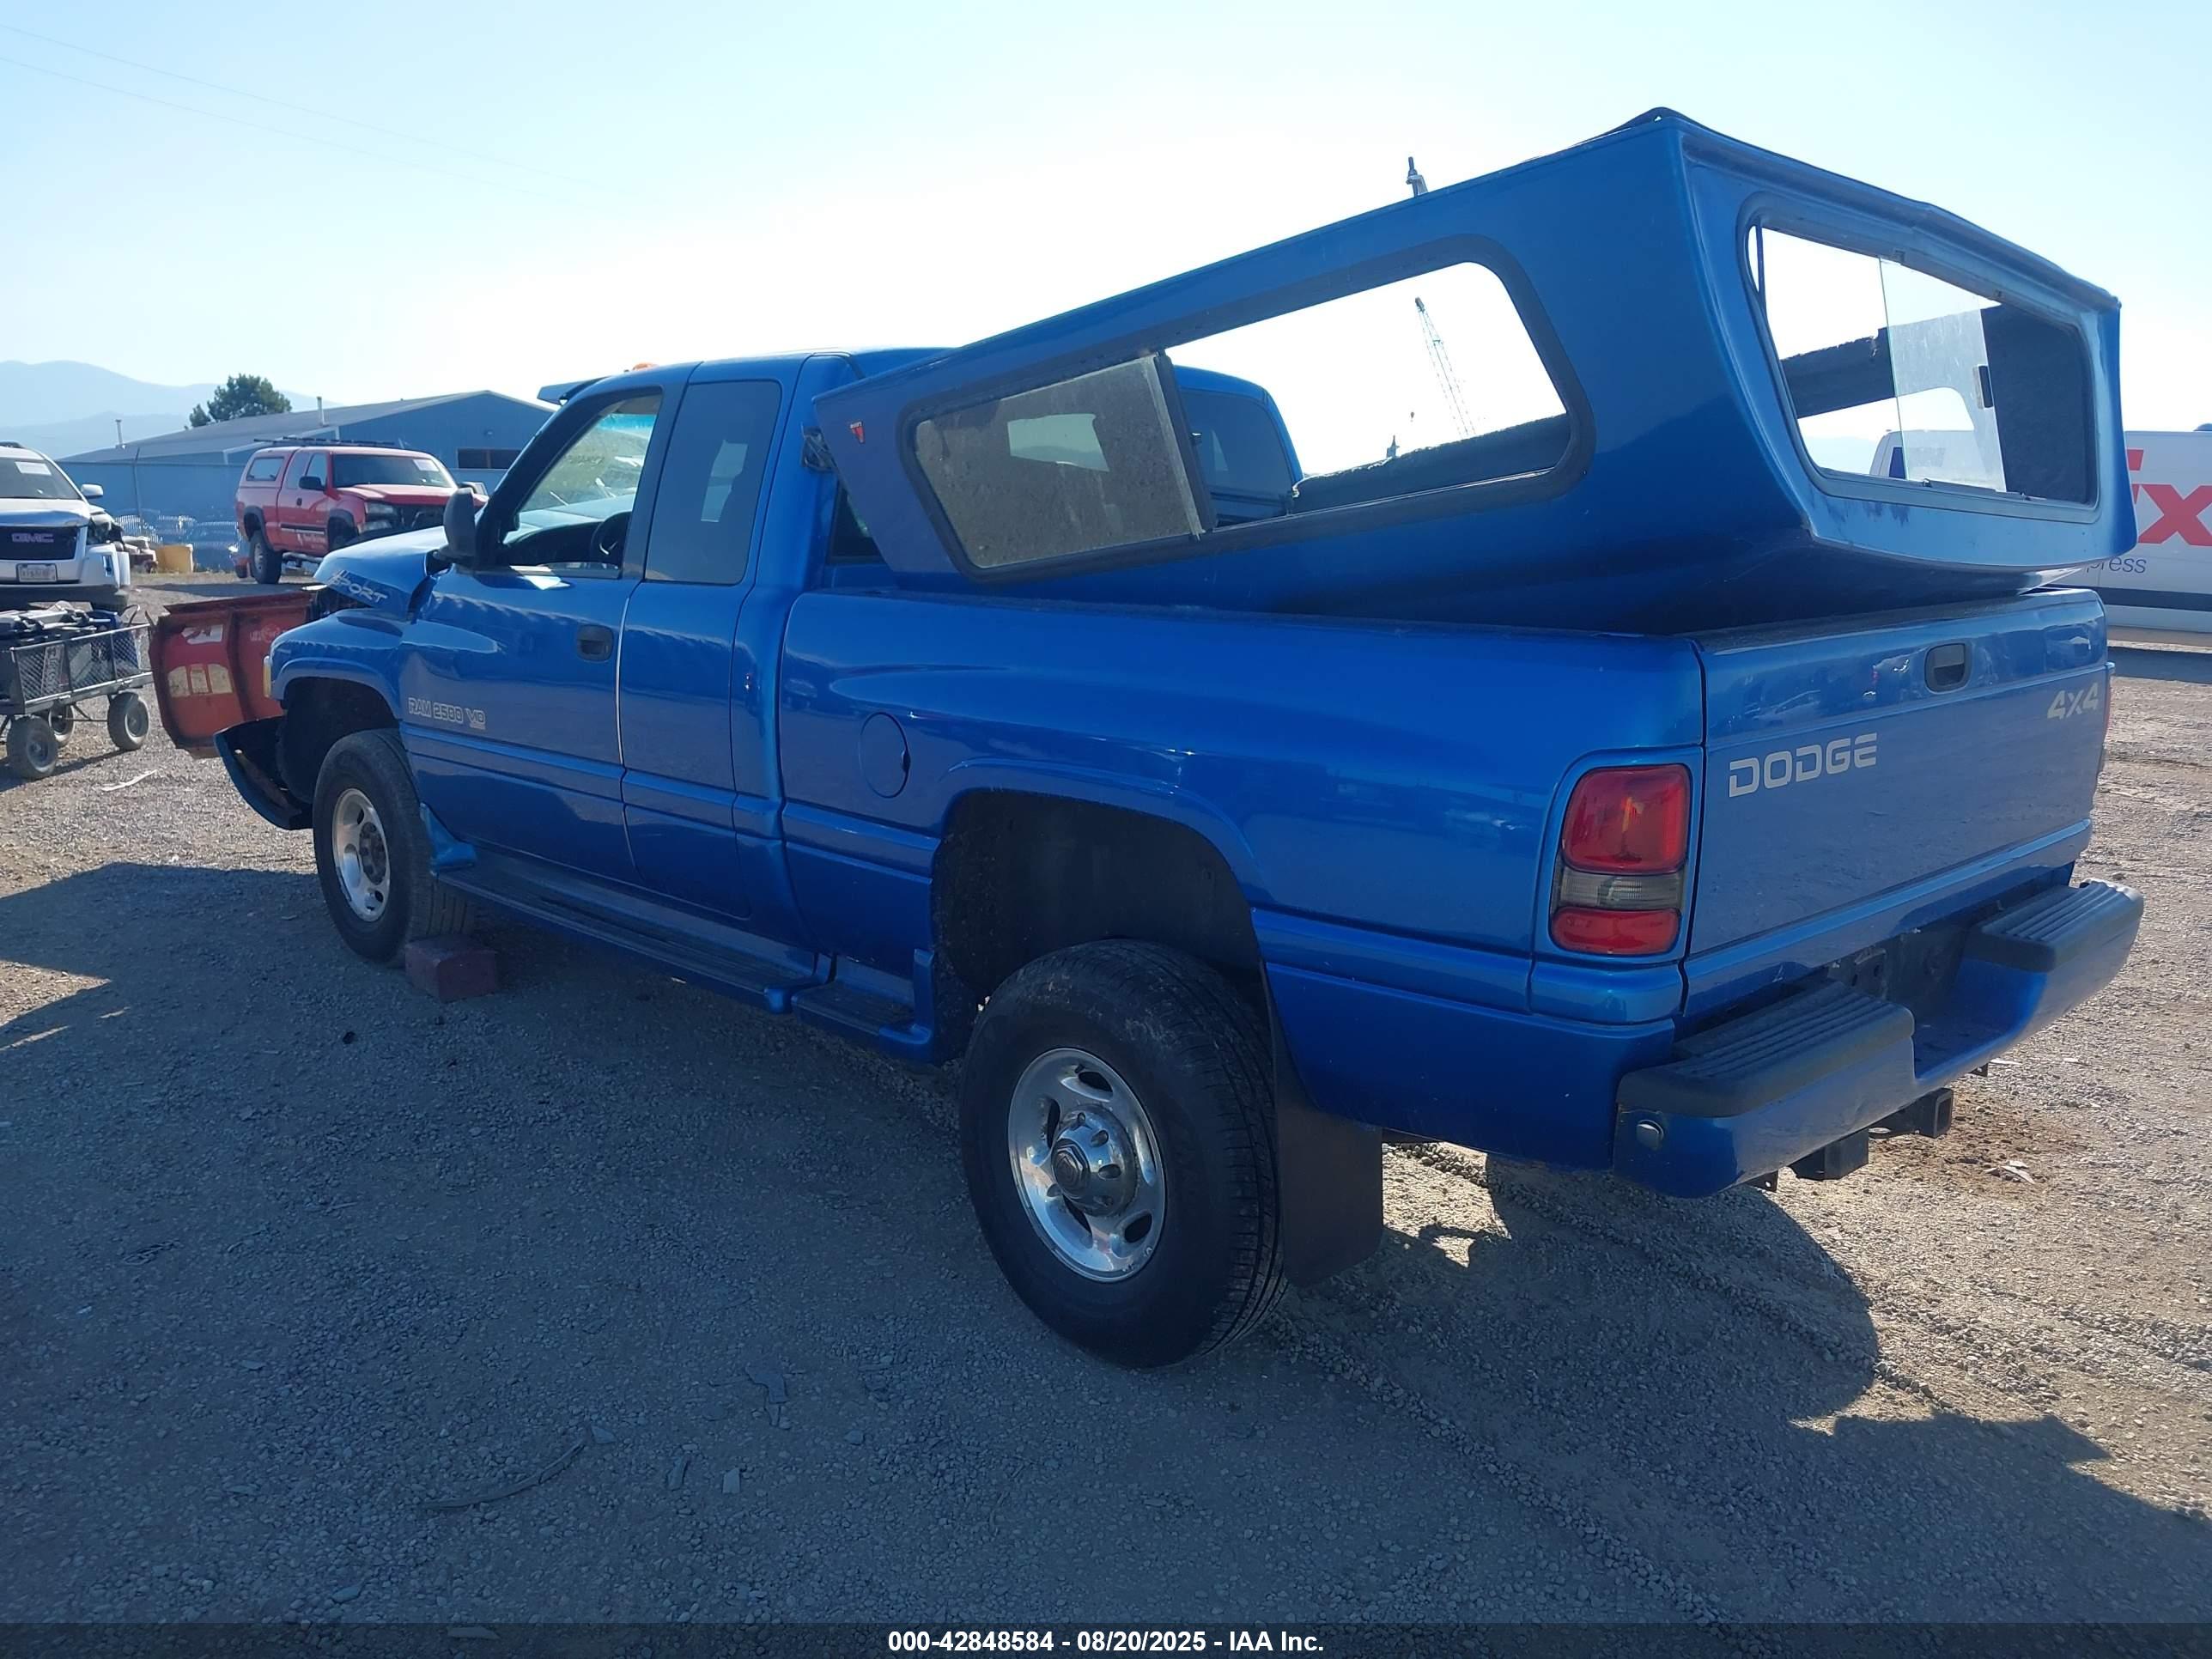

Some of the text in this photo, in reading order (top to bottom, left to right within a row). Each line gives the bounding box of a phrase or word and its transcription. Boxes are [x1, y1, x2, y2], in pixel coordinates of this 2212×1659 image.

[12, 533, 54, 543] GMC
[408, 696, 432, 718] RAM
[433, 702, 464, 724] 2500
[1729, 732, 1877, 798] DODGE
